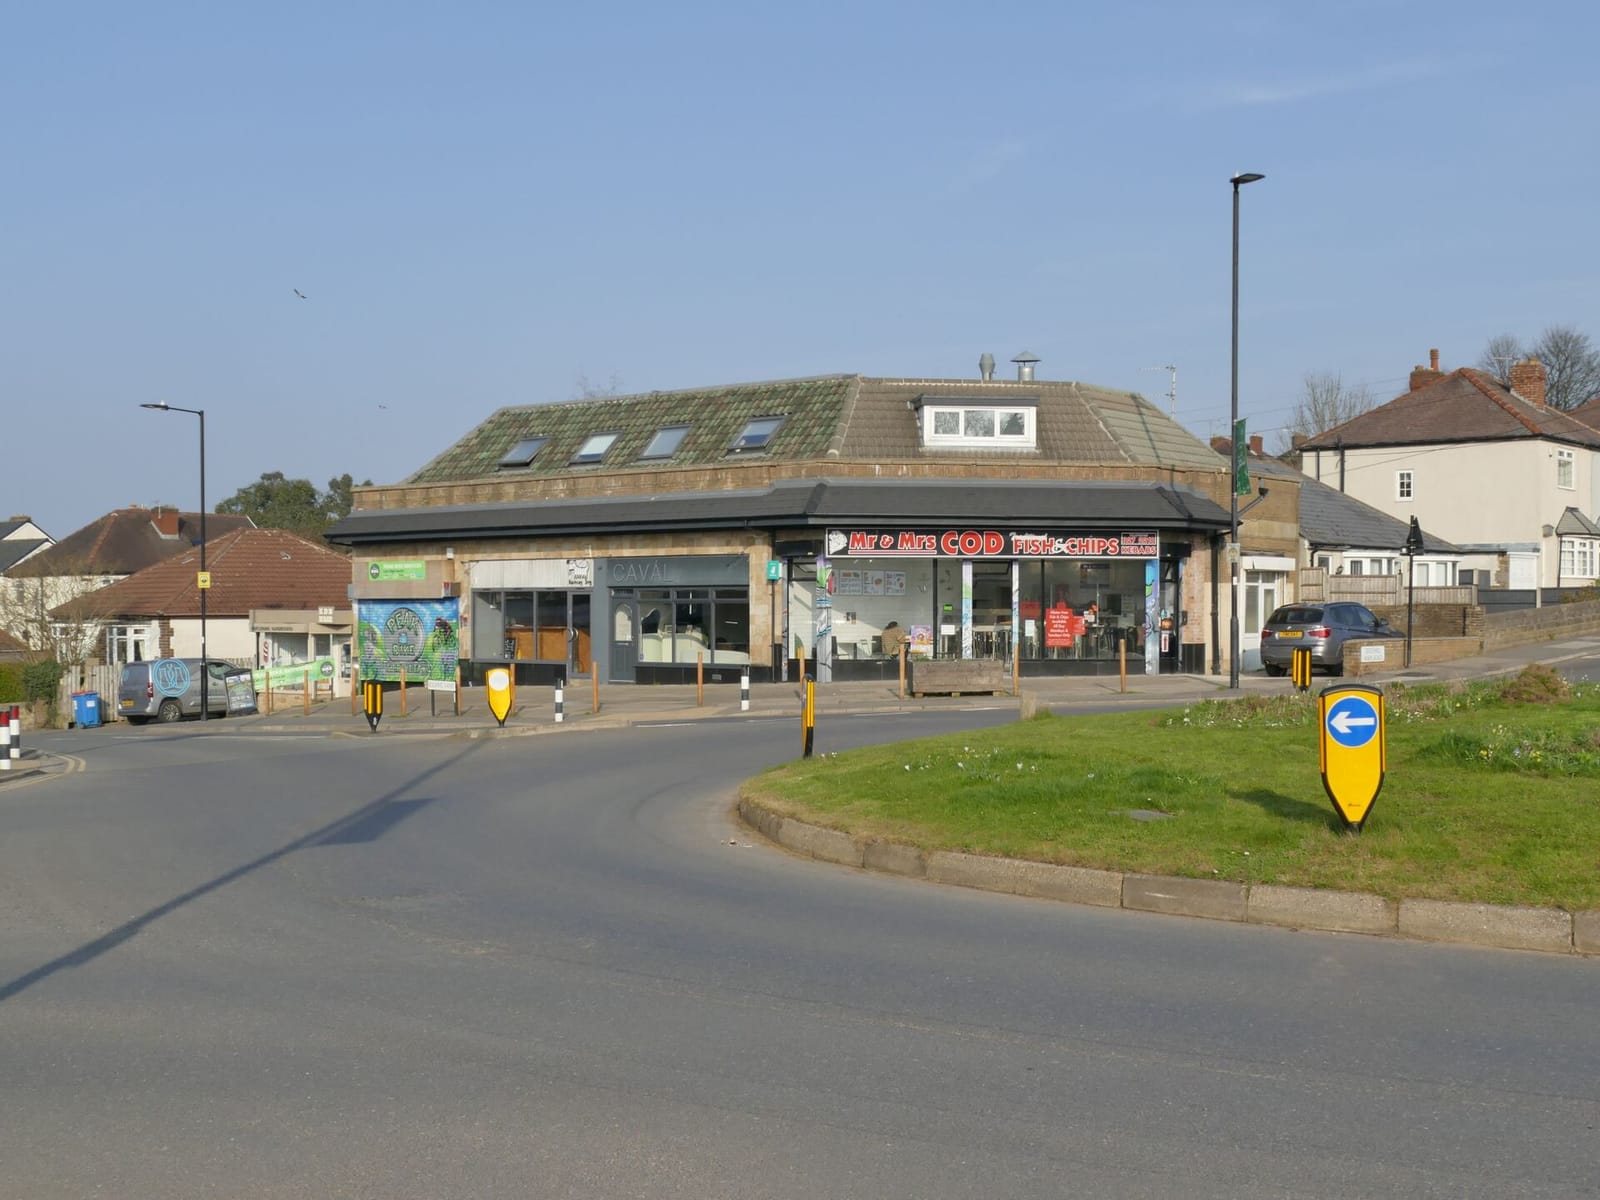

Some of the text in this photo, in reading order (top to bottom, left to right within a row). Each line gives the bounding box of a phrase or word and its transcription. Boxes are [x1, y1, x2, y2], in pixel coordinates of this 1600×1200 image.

[849, 531, 1004, 555] Mr & Mrs COD
[1013, 538, 1055, 555] FISH
[1053, 538, 1069, 554] &
[1066, 538, 1119, 555] CHIPS
[1121, 545, 1157, 555] KEBABS
[386, 611, 420, 636] PEAK
[392, 643, 416, 657] BIKE
